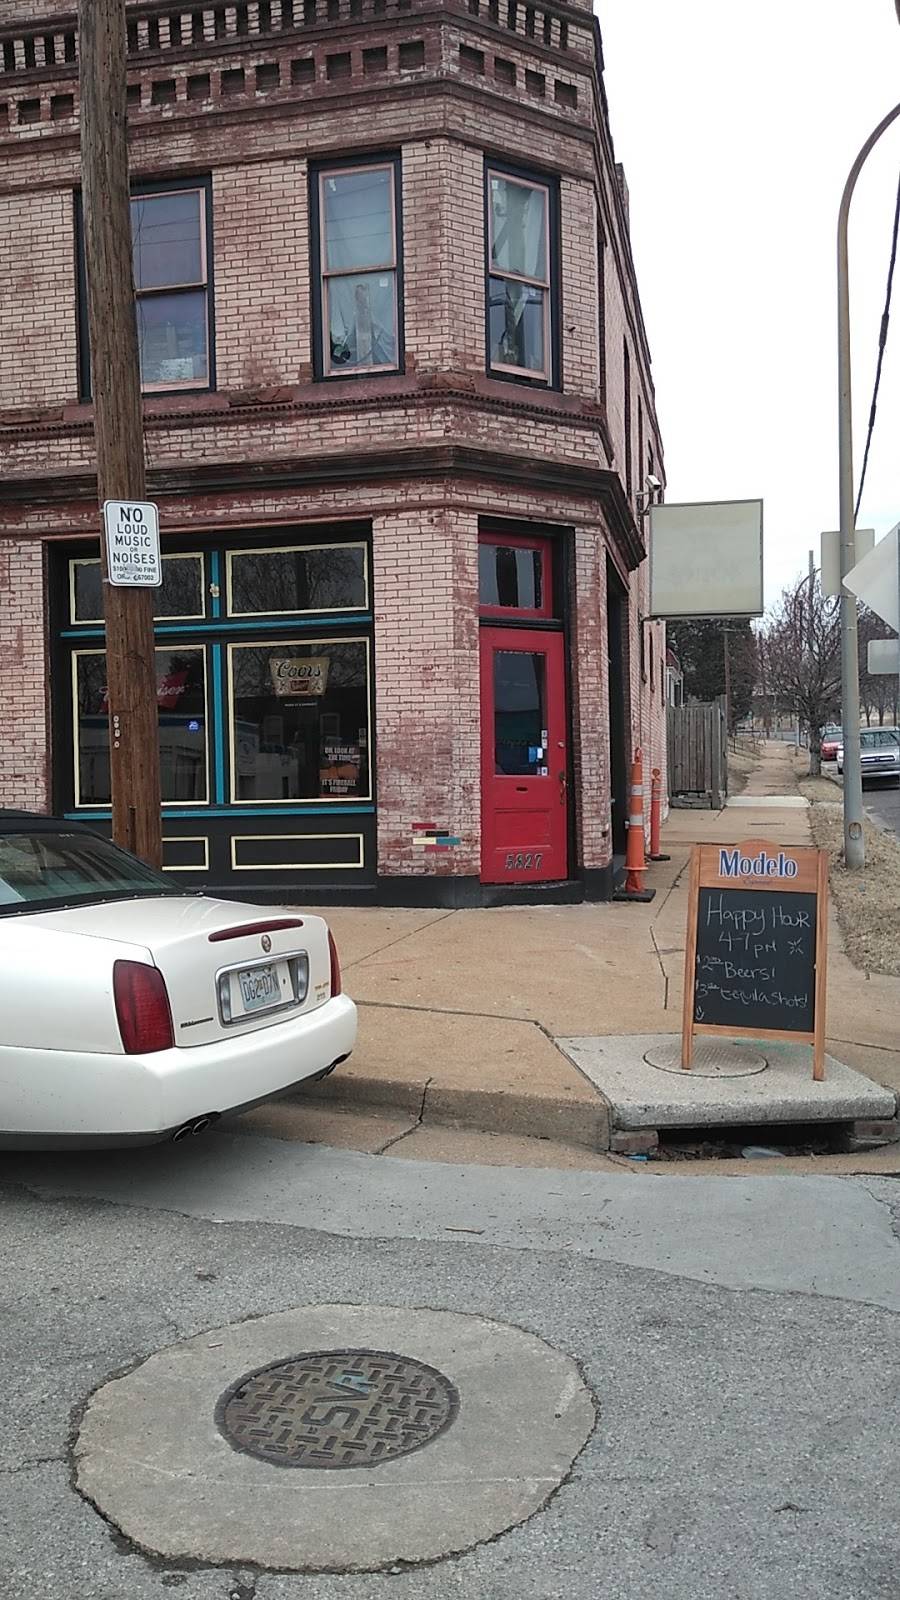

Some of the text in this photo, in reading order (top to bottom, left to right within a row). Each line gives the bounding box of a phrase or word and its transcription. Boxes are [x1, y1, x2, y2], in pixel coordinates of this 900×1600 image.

[119, 507, 143, 523] NO
[117, 523, 148, 536] LOUD
[115, 535, 151, 547] MUSIC
[113, 552, 156, 565] NOISES
[276, 661, 321, 678] Coors
[505, 853, 544, 871] 5827
[719, 849, 797, 878] Modelo
[706, 893, 766, 936] Happy
[724, 961, 776, 981] Beers!
